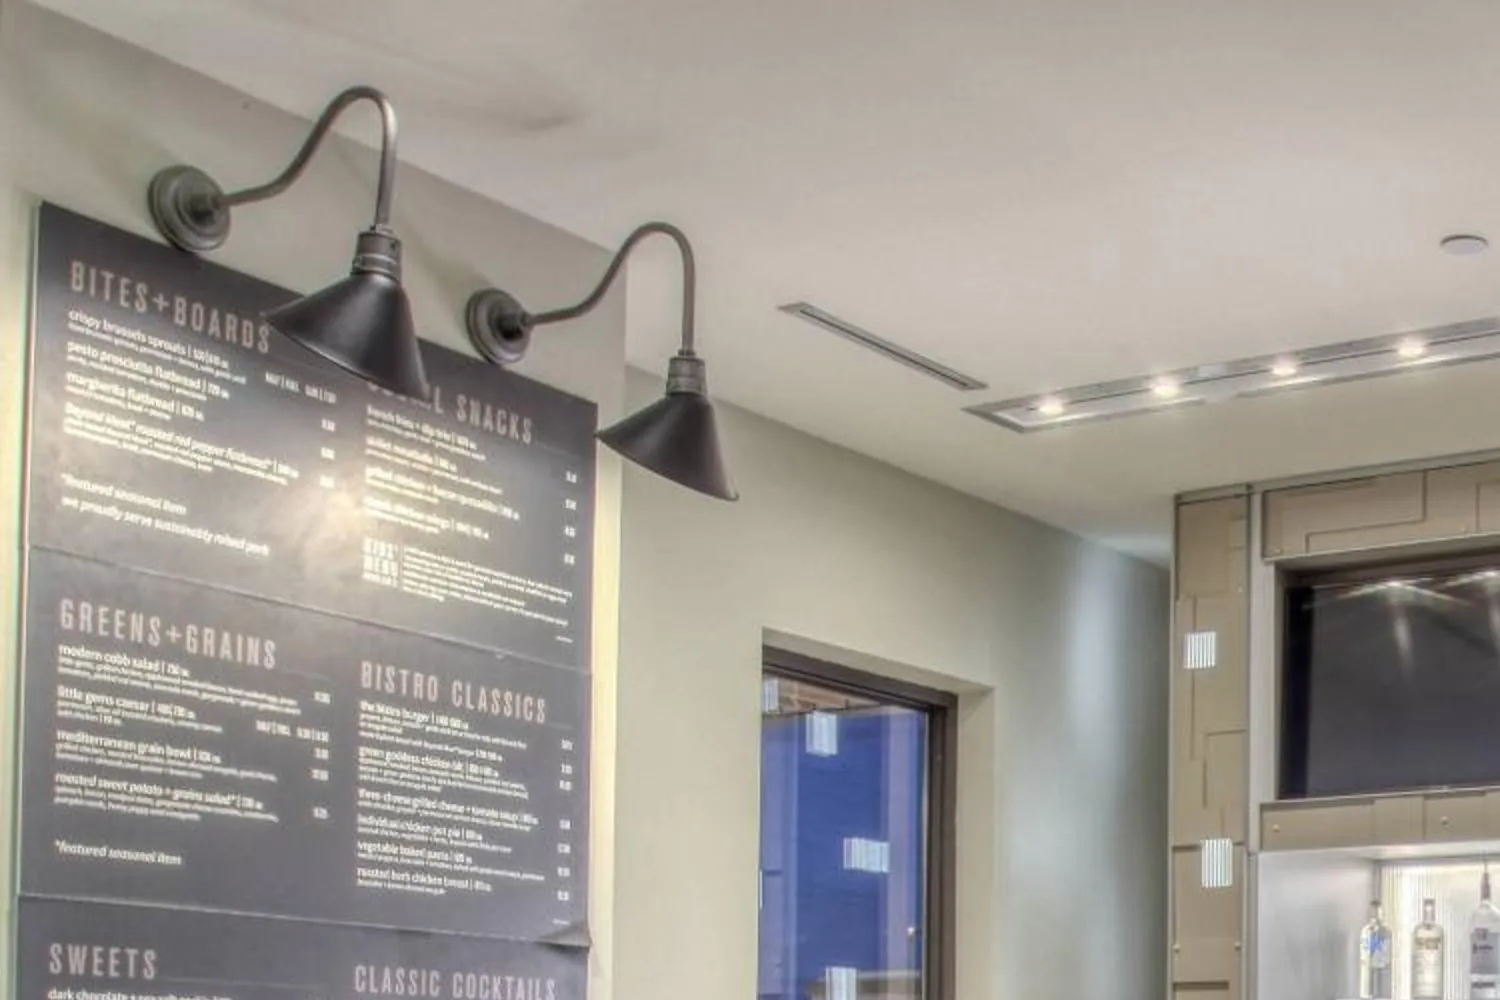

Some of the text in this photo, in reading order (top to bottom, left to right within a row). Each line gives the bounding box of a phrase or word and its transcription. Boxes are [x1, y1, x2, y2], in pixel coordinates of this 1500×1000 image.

[456, 393, 532, 444] SNACKS
[59, 598, 276, 670] GREENS+GRAINS
[361, 660, 546, 724] BISTRO CLASSICS
[49, 943, 157, 980] SWEETS
[354, 965, 441, 997] CLASSIC
[48, 989, 74, 1000] dark
